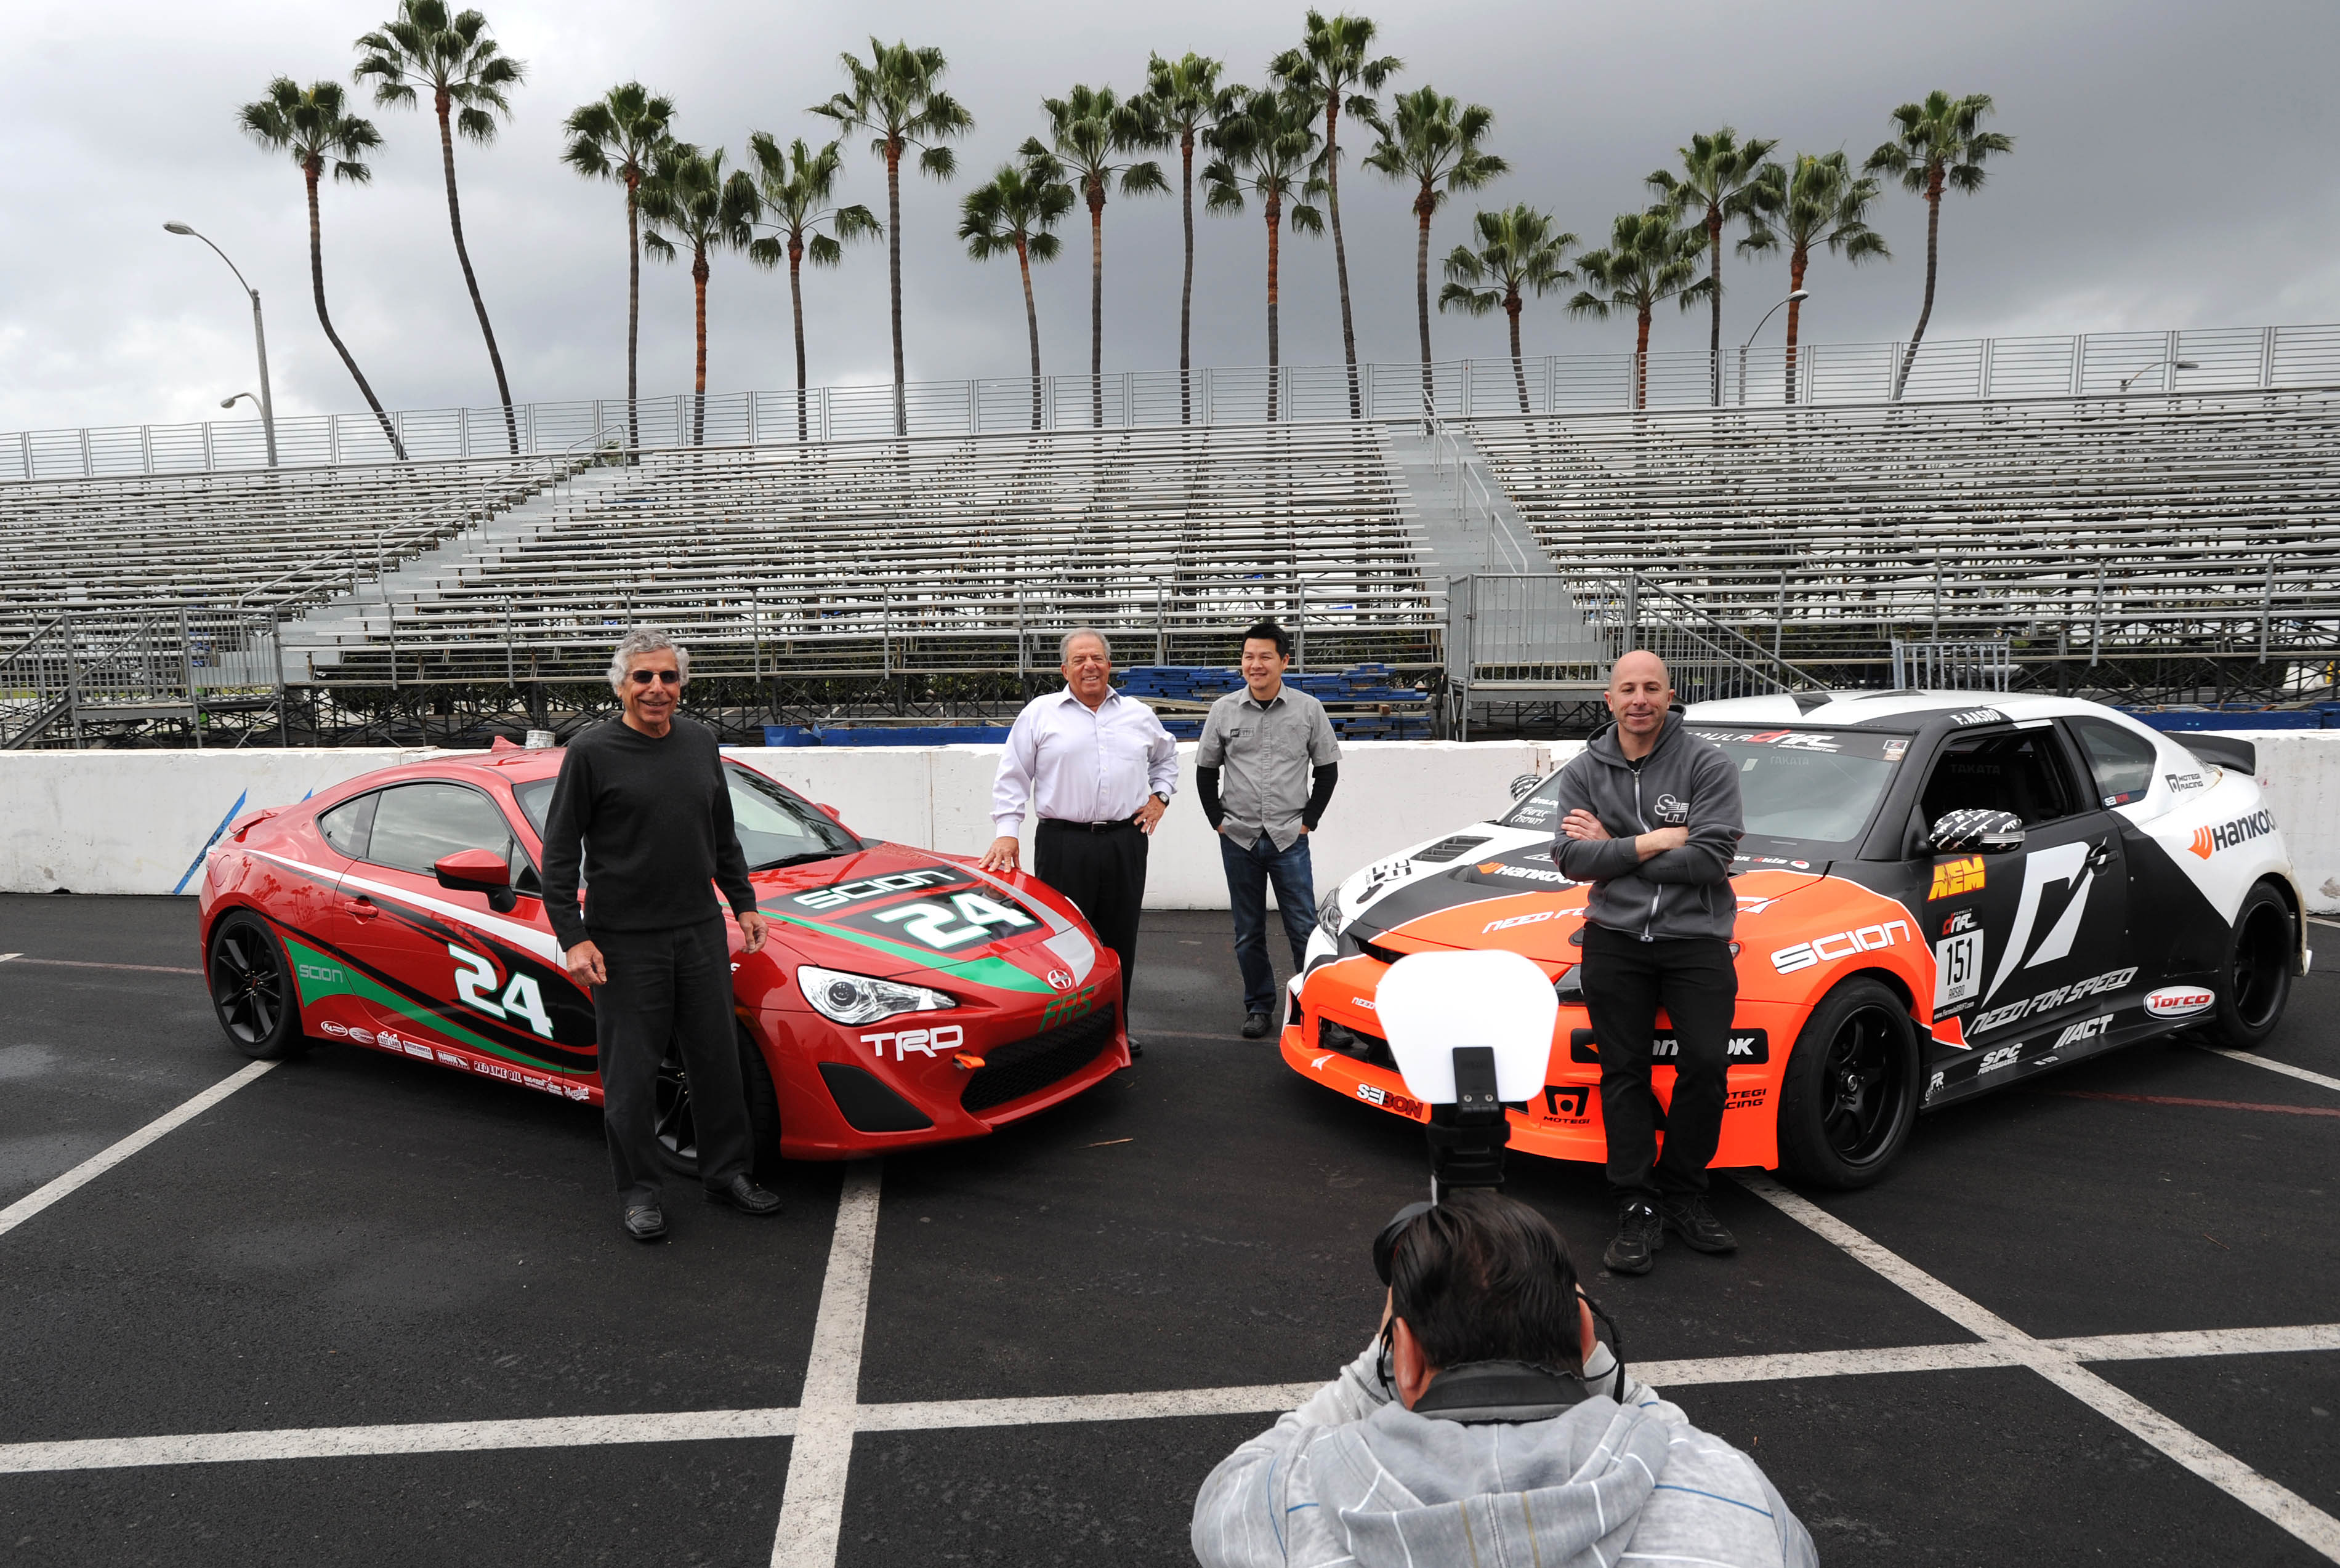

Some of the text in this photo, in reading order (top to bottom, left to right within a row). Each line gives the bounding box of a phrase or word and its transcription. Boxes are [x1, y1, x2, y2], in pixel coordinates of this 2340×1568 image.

[2178, 773, 2201, 782] MOTEGI
[2181, 781, 2203, 790] RACING
[793, 870, 956, 909] SCION
[1927, 854, 1985, 903] AEM
[872, 893, 1035, 949] 24
[1482, 911, 1554, 934] NEED
[1770, 919, 1910, 975] SCION
[299, 964, 343, 983] SCION
[1947, 938, 1972, 986] 151
[448, 943, 554, 1040] 24
[1964, 967, 2139, 1038] NEED FOR SPEED
[860, 1024, 963, 1061] TRD
[1980, 1043, 2023, 1067] SPC
[474, 1061, 489, 1073] RED
[490, 1065, 507, 1079] LINE
[508, 1070, 522, 1082] OIL
[1357, 1084, 1424, 1119] SEIBON
[1725, 1088, 1767, 1099] TEGI
[1725, 1099, 1764, 1109] CING
[1543, 1116, 1591, 1124] MOTEGI
